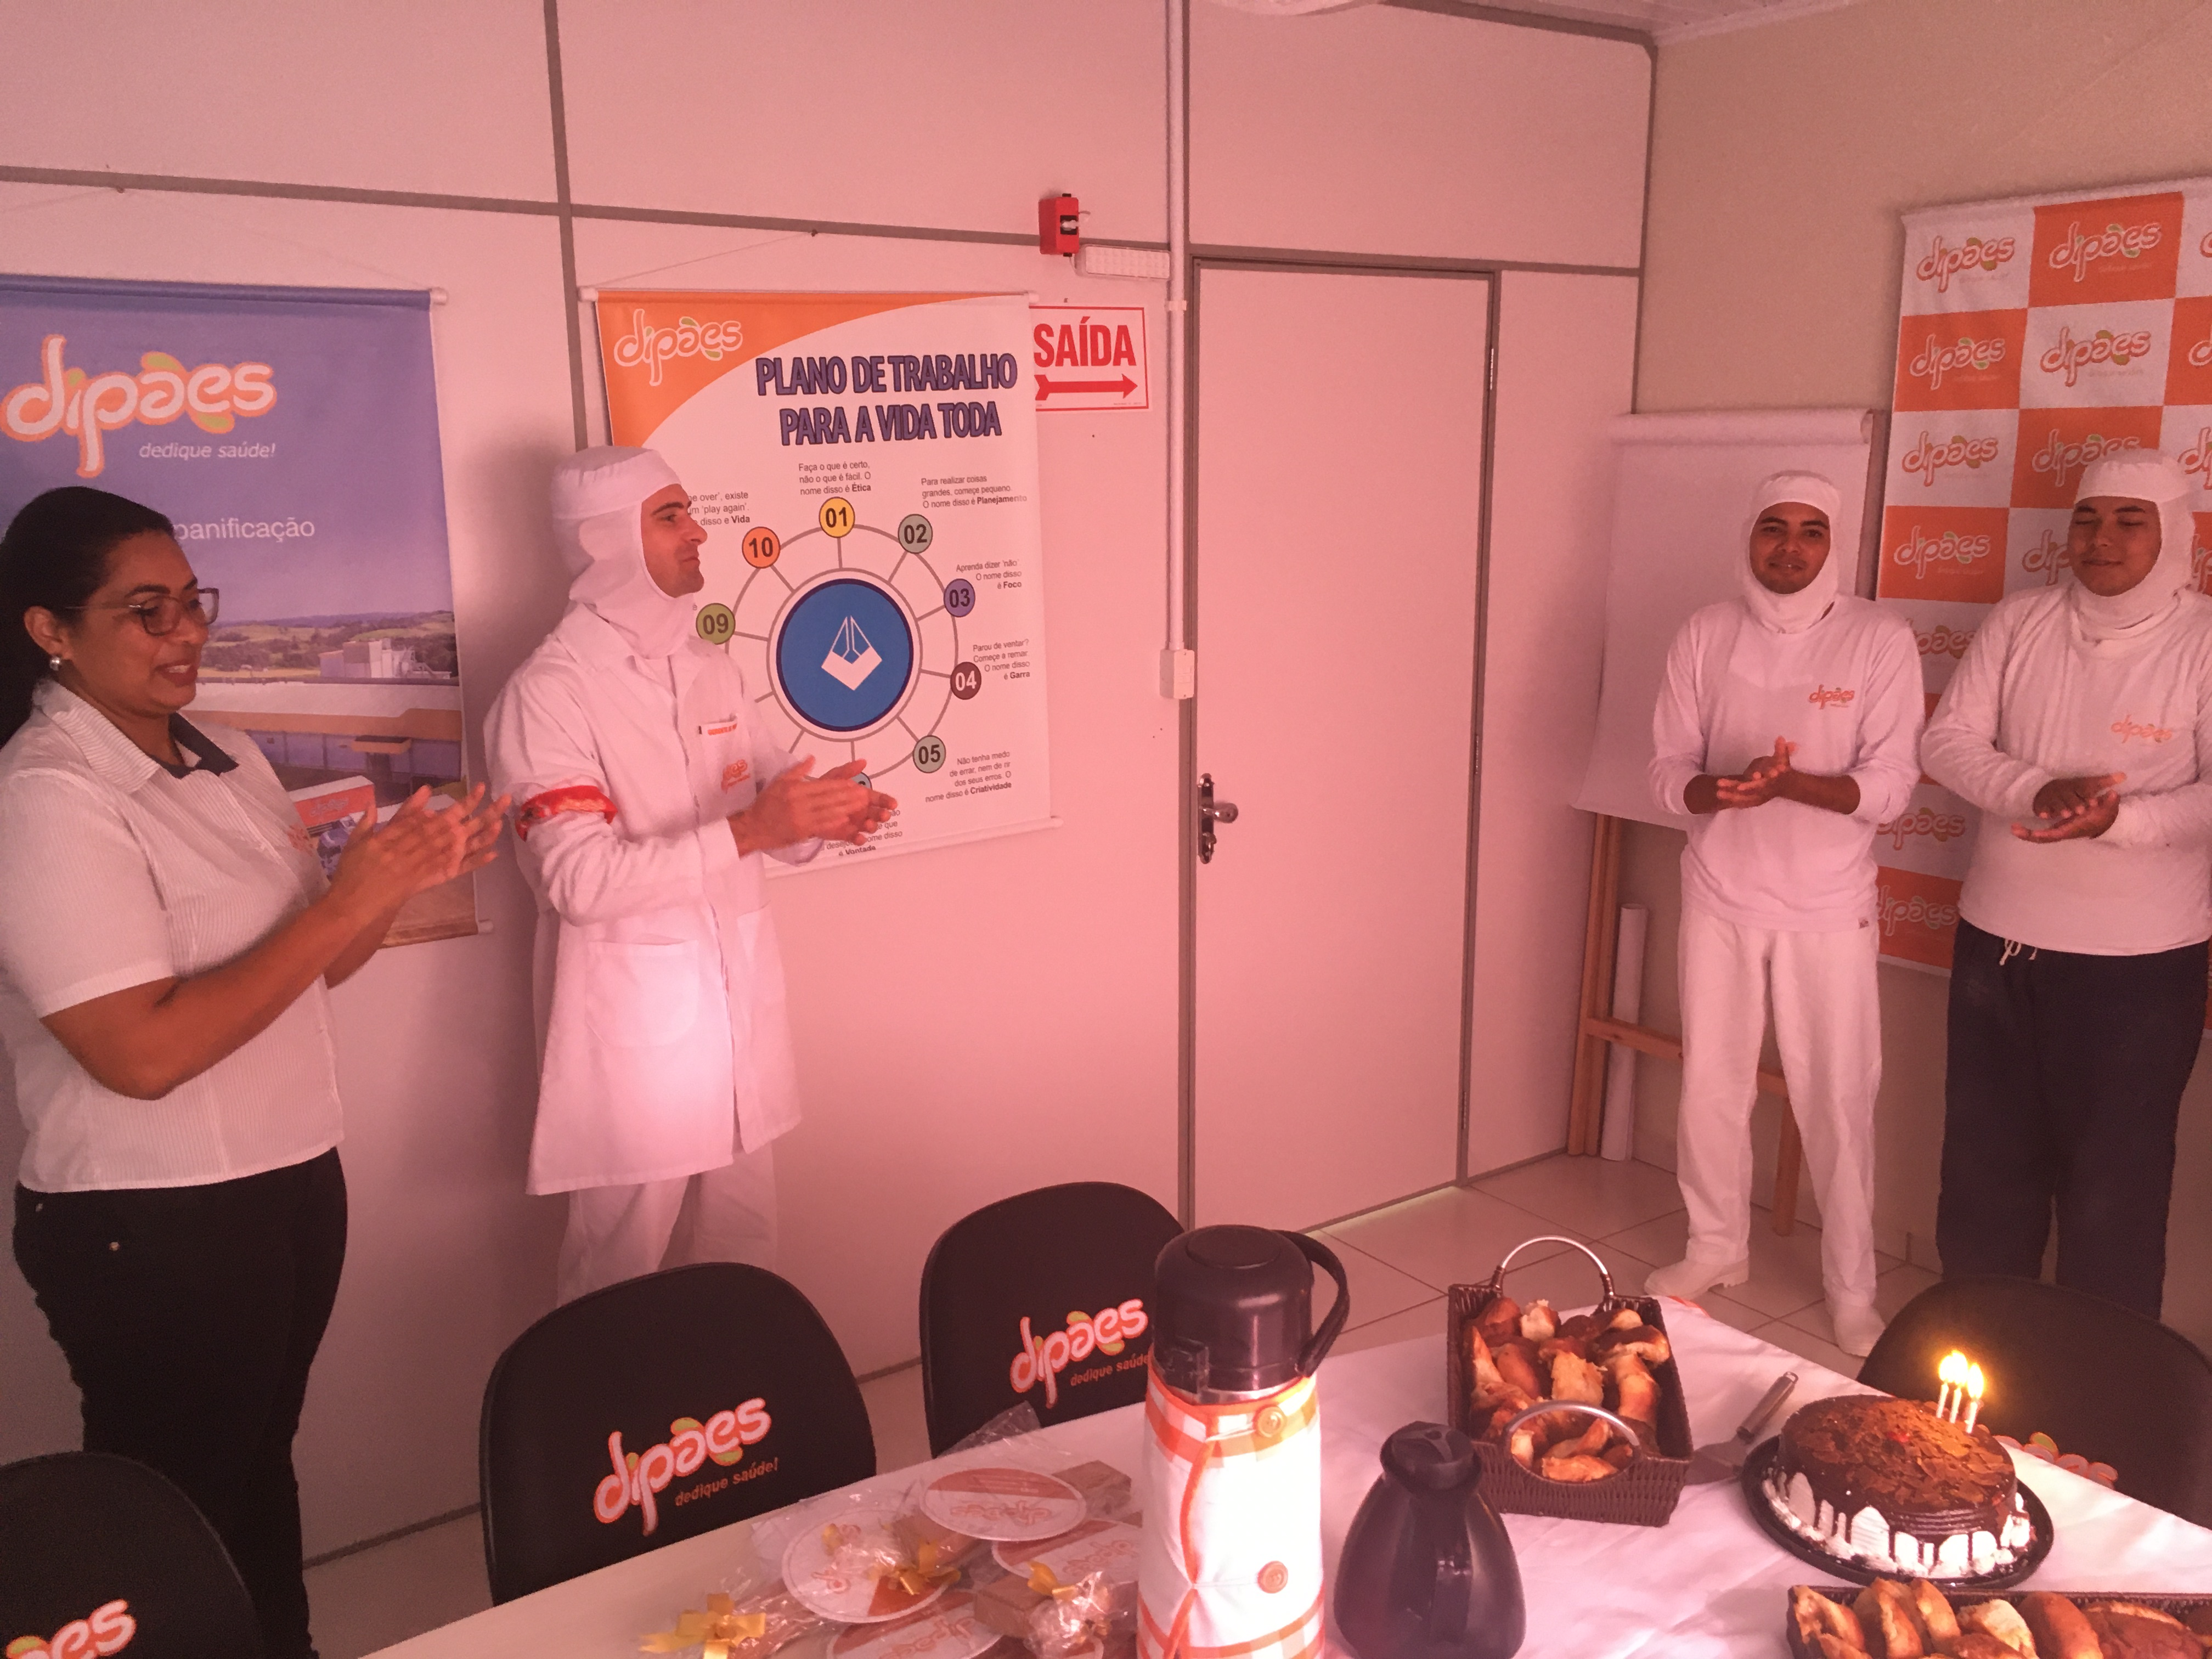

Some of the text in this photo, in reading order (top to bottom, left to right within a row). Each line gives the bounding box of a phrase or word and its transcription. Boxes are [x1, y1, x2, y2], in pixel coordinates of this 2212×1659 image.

[1034, 316, 1137, 367] SAÍDA
[755, 353, 1018, 396] PLANO DE TRABALHO
[779, 401, 1002, 445] PARA A VIDA TODA
[139, 441, 276, 460] dedique saúde!
[798, 463, 817, 473] Faça
[826, 463, 840, 472] que
[799, 475, 814, 483] não
[822, 475, 837, 483] que
[864, 471, 871, 480] O
[921, 475, 988, 486] Para realizar coisas
[725, 491, 749, 500] existe
[800, 487, 822, 495] nome
[823, 486, 843, 494] disso
[851, 482, 872, 492] Ética
[922, 500, 929, 509] O
[931, 500, 951, 508] nome
[952, 498, 970, 506] disso
[977, 494, 1028, 505] Planejamento
[700, 517, 722, 526] disso
[731, 515, 751, 523] Vida
[825, 507, 848, 528] 01
[904, 524, 927, 545] 02
[748, 537, 774, 558] 10
[956, 562, 983, 573] Aprenda
[984, 560, 1001, 569] dizer
[976, 573, 981, 581] O
[949, 589, 970, 608] 03
[703, 613, 728, 634] 09
[973, 644, 992, 652] Parou
[984, 664, 990, 673] O
[955, 671, 977, 691] 04
[918, 744, 940, 765] 05
[972, 754, 990, 763] tenha
[991, 751, 1010, 759] medo
[925, 794, 944, 803] nome
[945, 791, 963, 799] disso
[970, 782, 1012, 794] Criatividade
[884, 821, 898, 830] que
[867, 834, 883, 843] ome
[883, 831, 903, 839] disso
[1070, 1364, 1113, 1387] dedique
[675, 1457, 778, 1506] dedique saúde!
